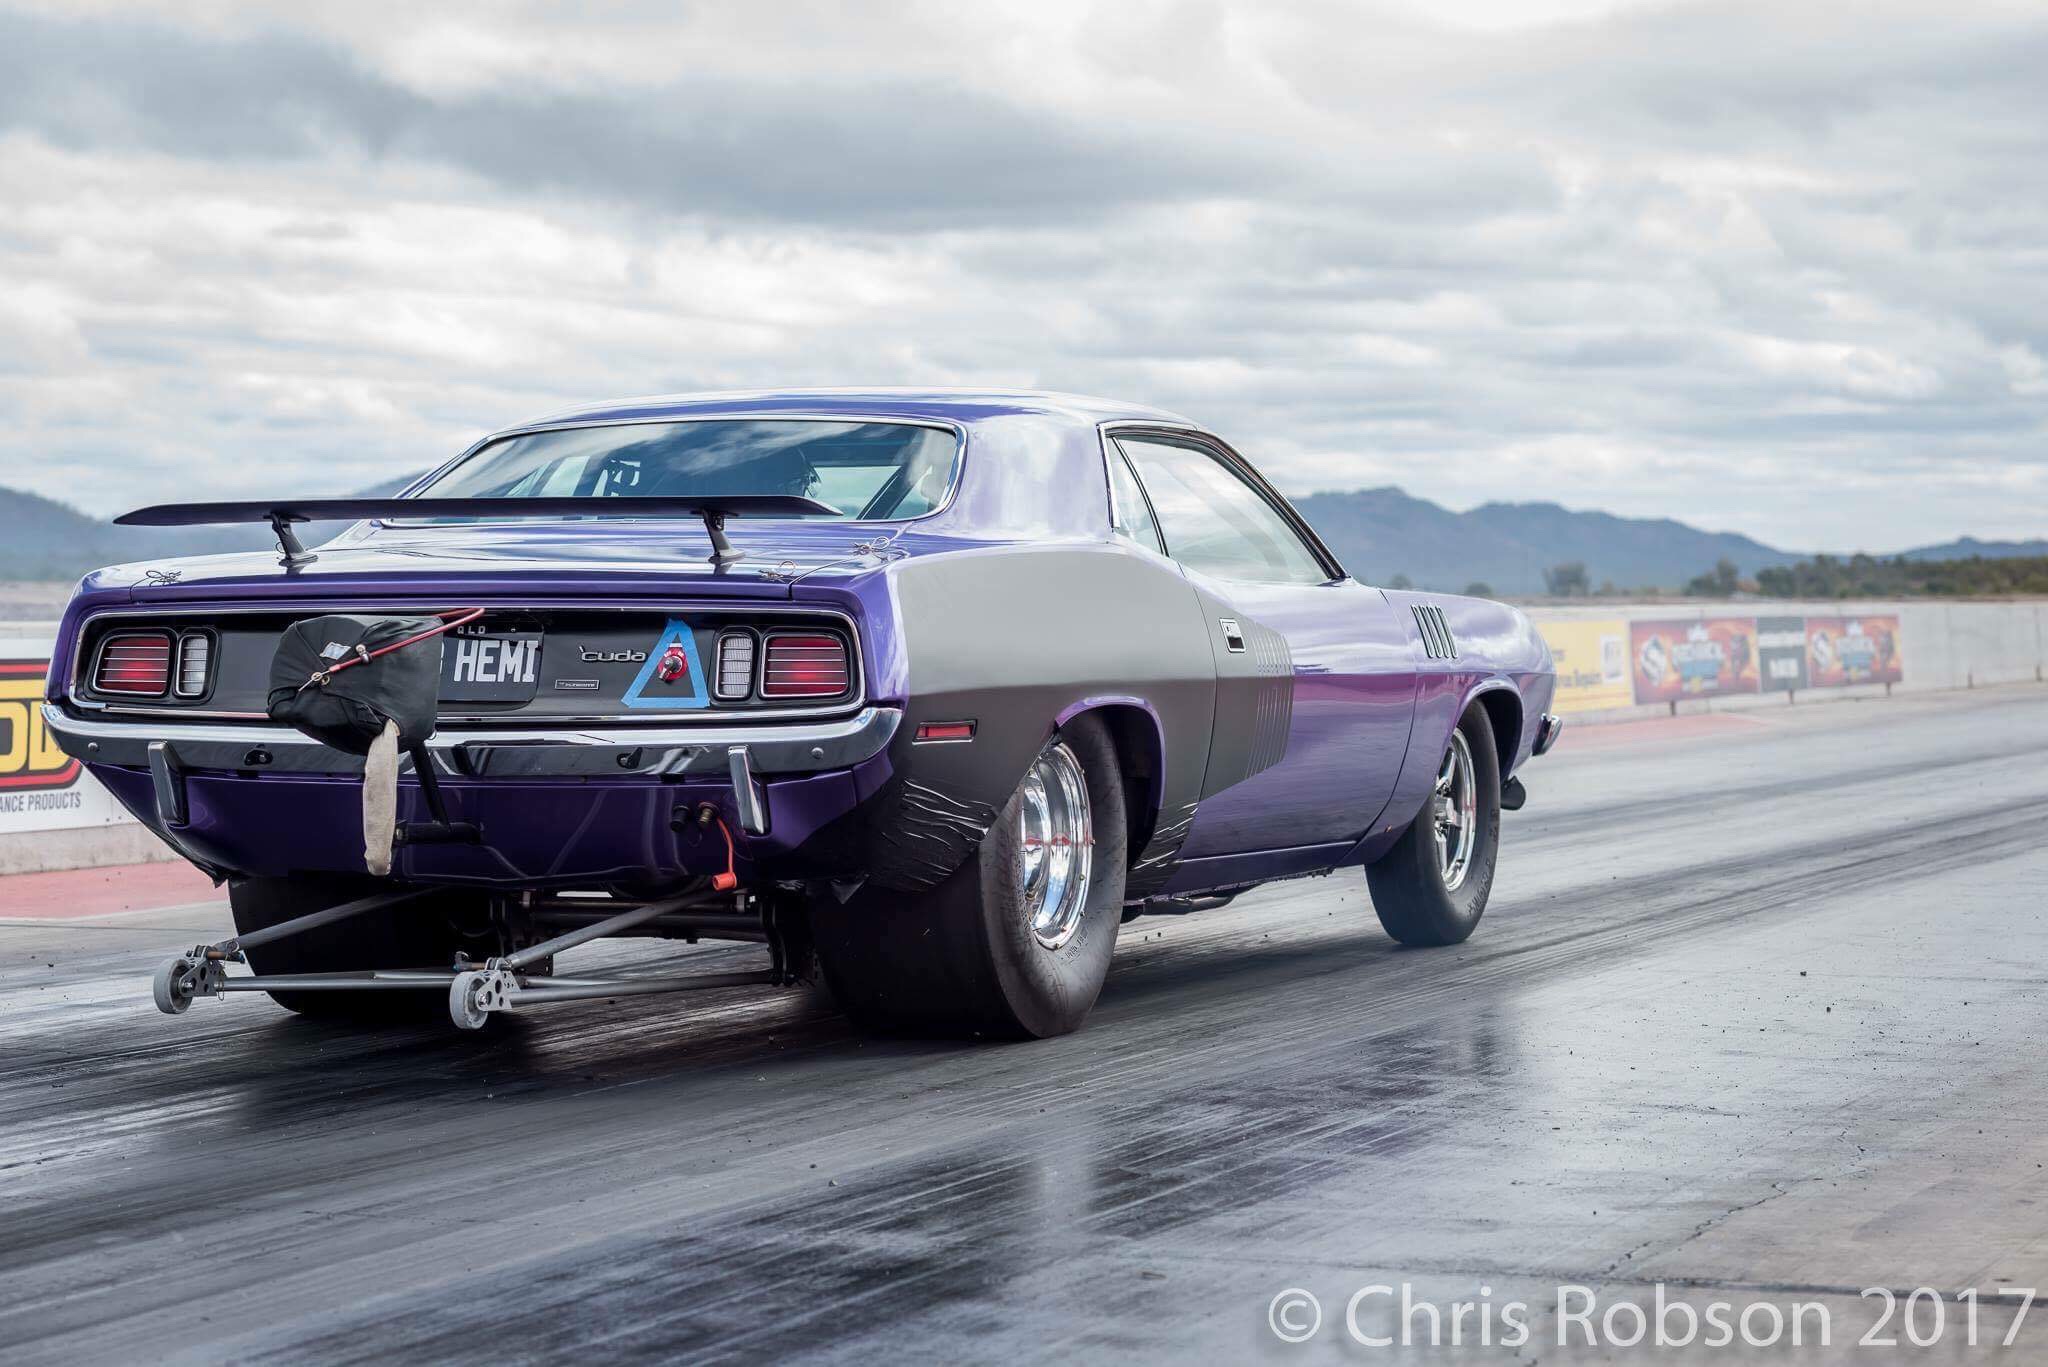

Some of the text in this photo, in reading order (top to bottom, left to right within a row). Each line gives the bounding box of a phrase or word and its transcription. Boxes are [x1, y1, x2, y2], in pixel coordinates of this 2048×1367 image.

[457, 625, 486, 635] QLD
[453, 639, 539, 683] HEMI
[27, 791, 81, 811] PRODUCTS
